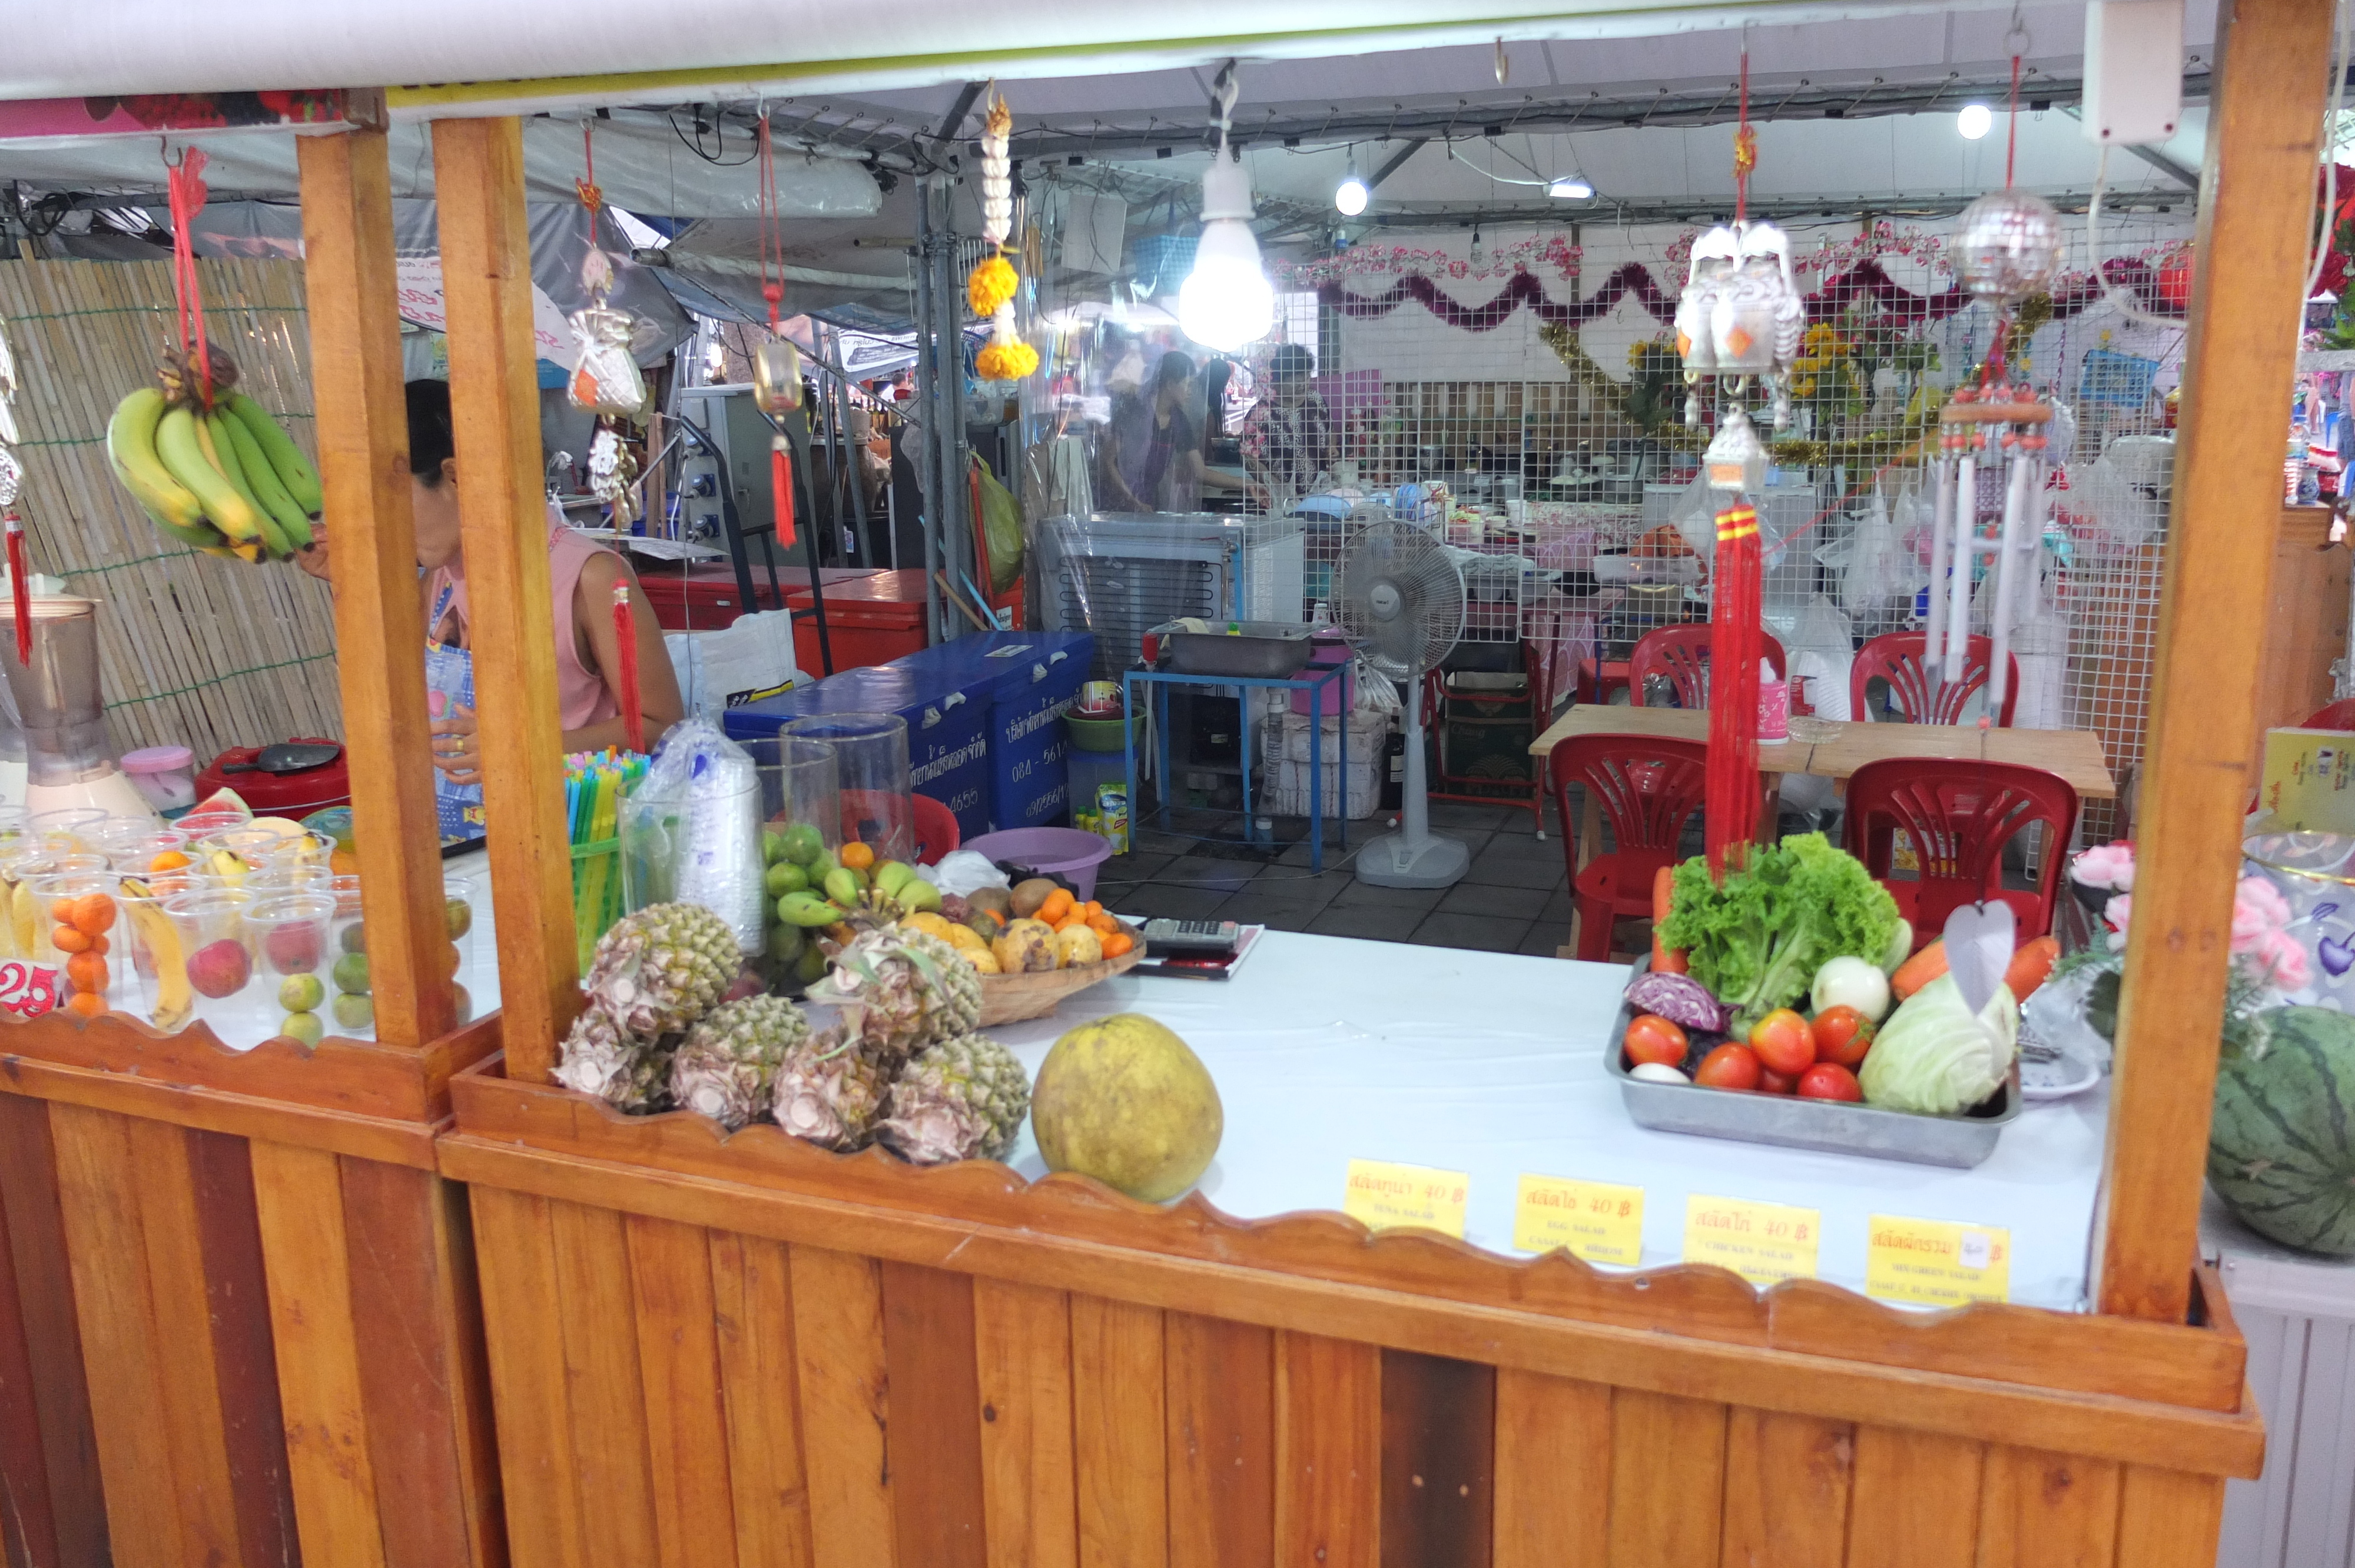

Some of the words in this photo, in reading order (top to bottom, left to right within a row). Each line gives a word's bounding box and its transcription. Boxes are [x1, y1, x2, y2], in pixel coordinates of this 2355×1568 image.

[1044, 739, 1068, 765] 5614
[944, 786, 979, 813] 4655
[0, 962, 58, 1018] 25
[1424, 1184, 1447, 1200] 40
[1589, 1197, 1612, 1214] 40
[1763, 1220, 1789, 1237] 40
